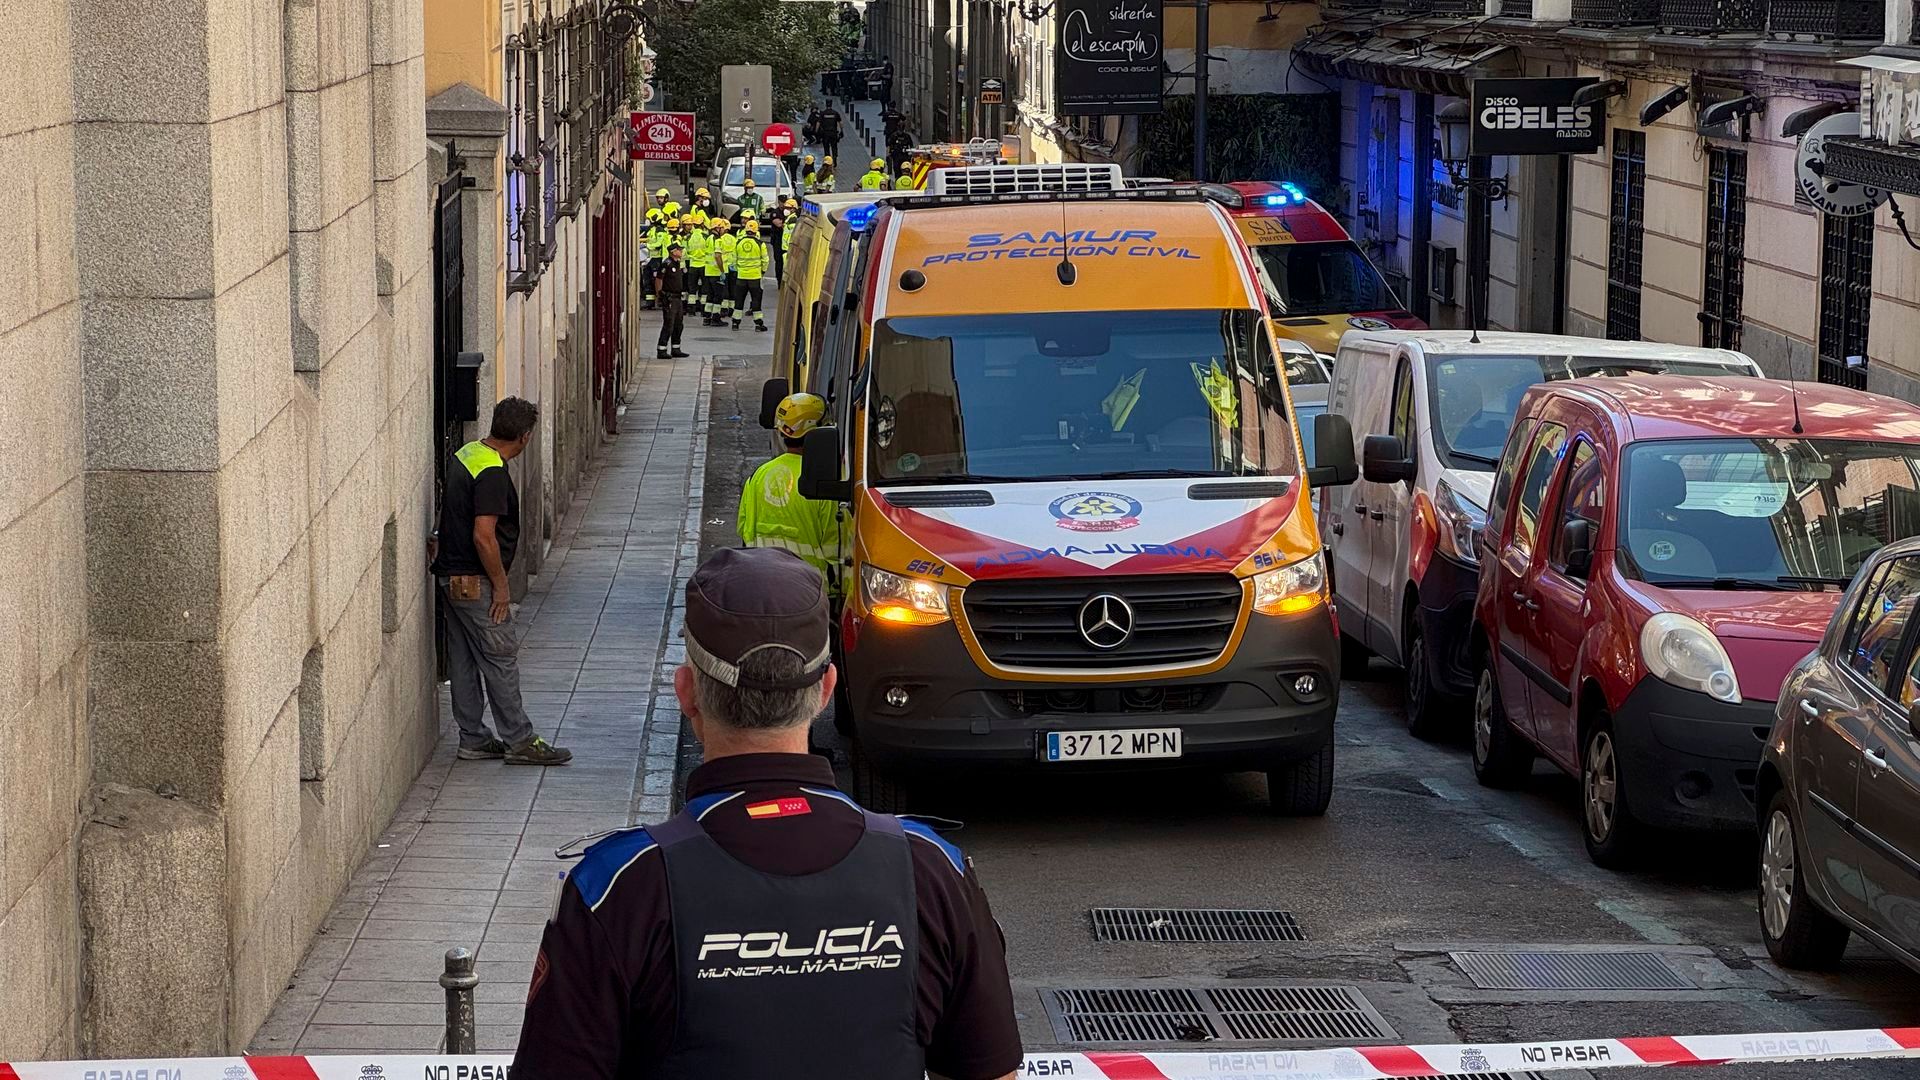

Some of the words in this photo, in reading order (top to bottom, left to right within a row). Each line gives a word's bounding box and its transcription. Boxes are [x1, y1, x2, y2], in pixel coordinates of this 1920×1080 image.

[1109, 1, 1156, 20] sidrería
[1089, 31, 1148, 62] escarpín
[982, 93, 1001, 102] ATM
[650, 127, 672, 138] 24h
[644, 151, 680, 160] BEBIDAS
[1802, 178, 1836, 214] JUAN
[966, 230, 1157, 248] SAMUR
[921, 245, 1118, 268] PROTECCIÓN
[1127, 246, 1201, 259] CIVIL
[906, 559, 946, 577] 8614
[1254, 548, 1286, 569] 8614
[1063, 734, 1123, 756] 3712
[1131, 732, 1176, 754] MPN
[698, 920, 905, 961] POLICÍA
[697, 964, 799, 979] MUNICIPAL
[799, 954, 902, 974] MADRID
[1521, 1047, 1546, 1063] NO
[1550, 1045, 1611, 1062] PASAR
[425, 1065, 449, 1080] NO
